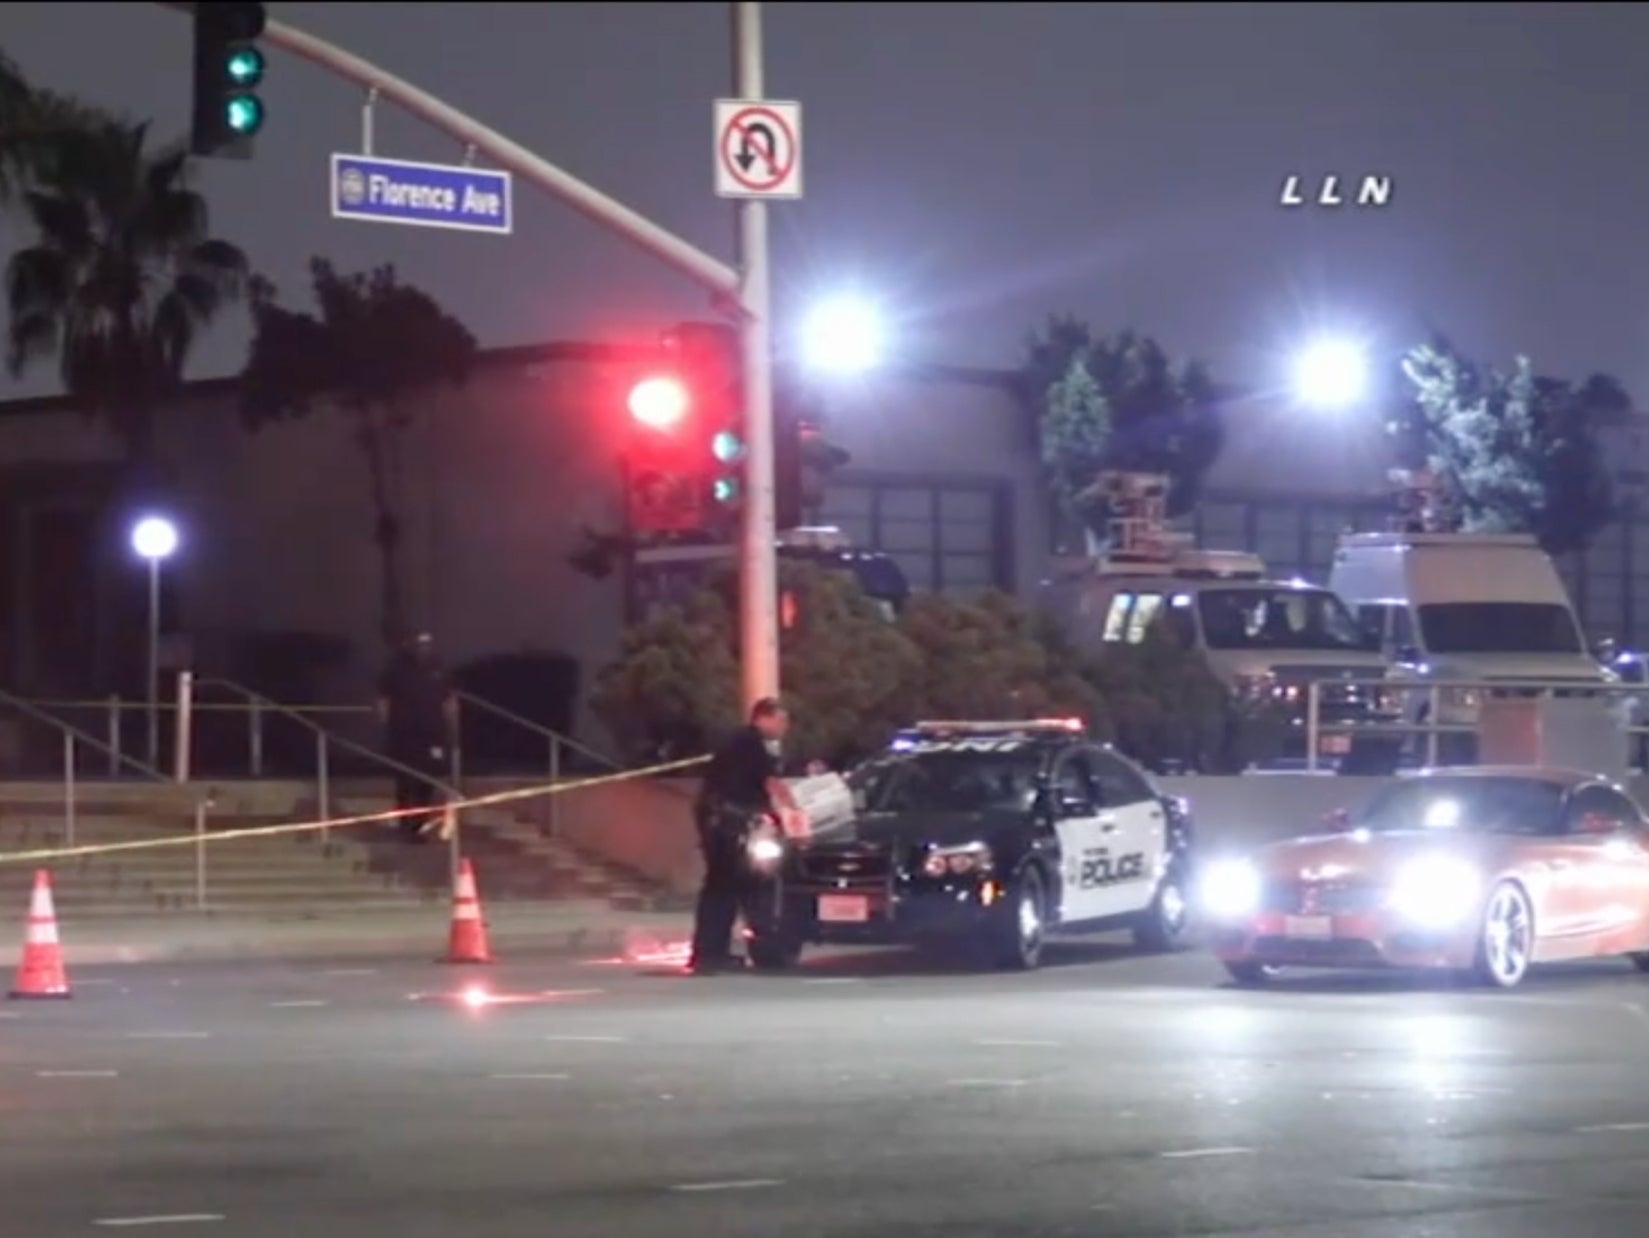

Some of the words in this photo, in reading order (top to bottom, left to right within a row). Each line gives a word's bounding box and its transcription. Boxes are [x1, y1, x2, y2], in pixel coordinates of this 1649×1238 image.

[369, 174, 456, 211] Florence
[461, 184, 499, 216] Ave
[1081, 852, 1143, 887] POLICE
